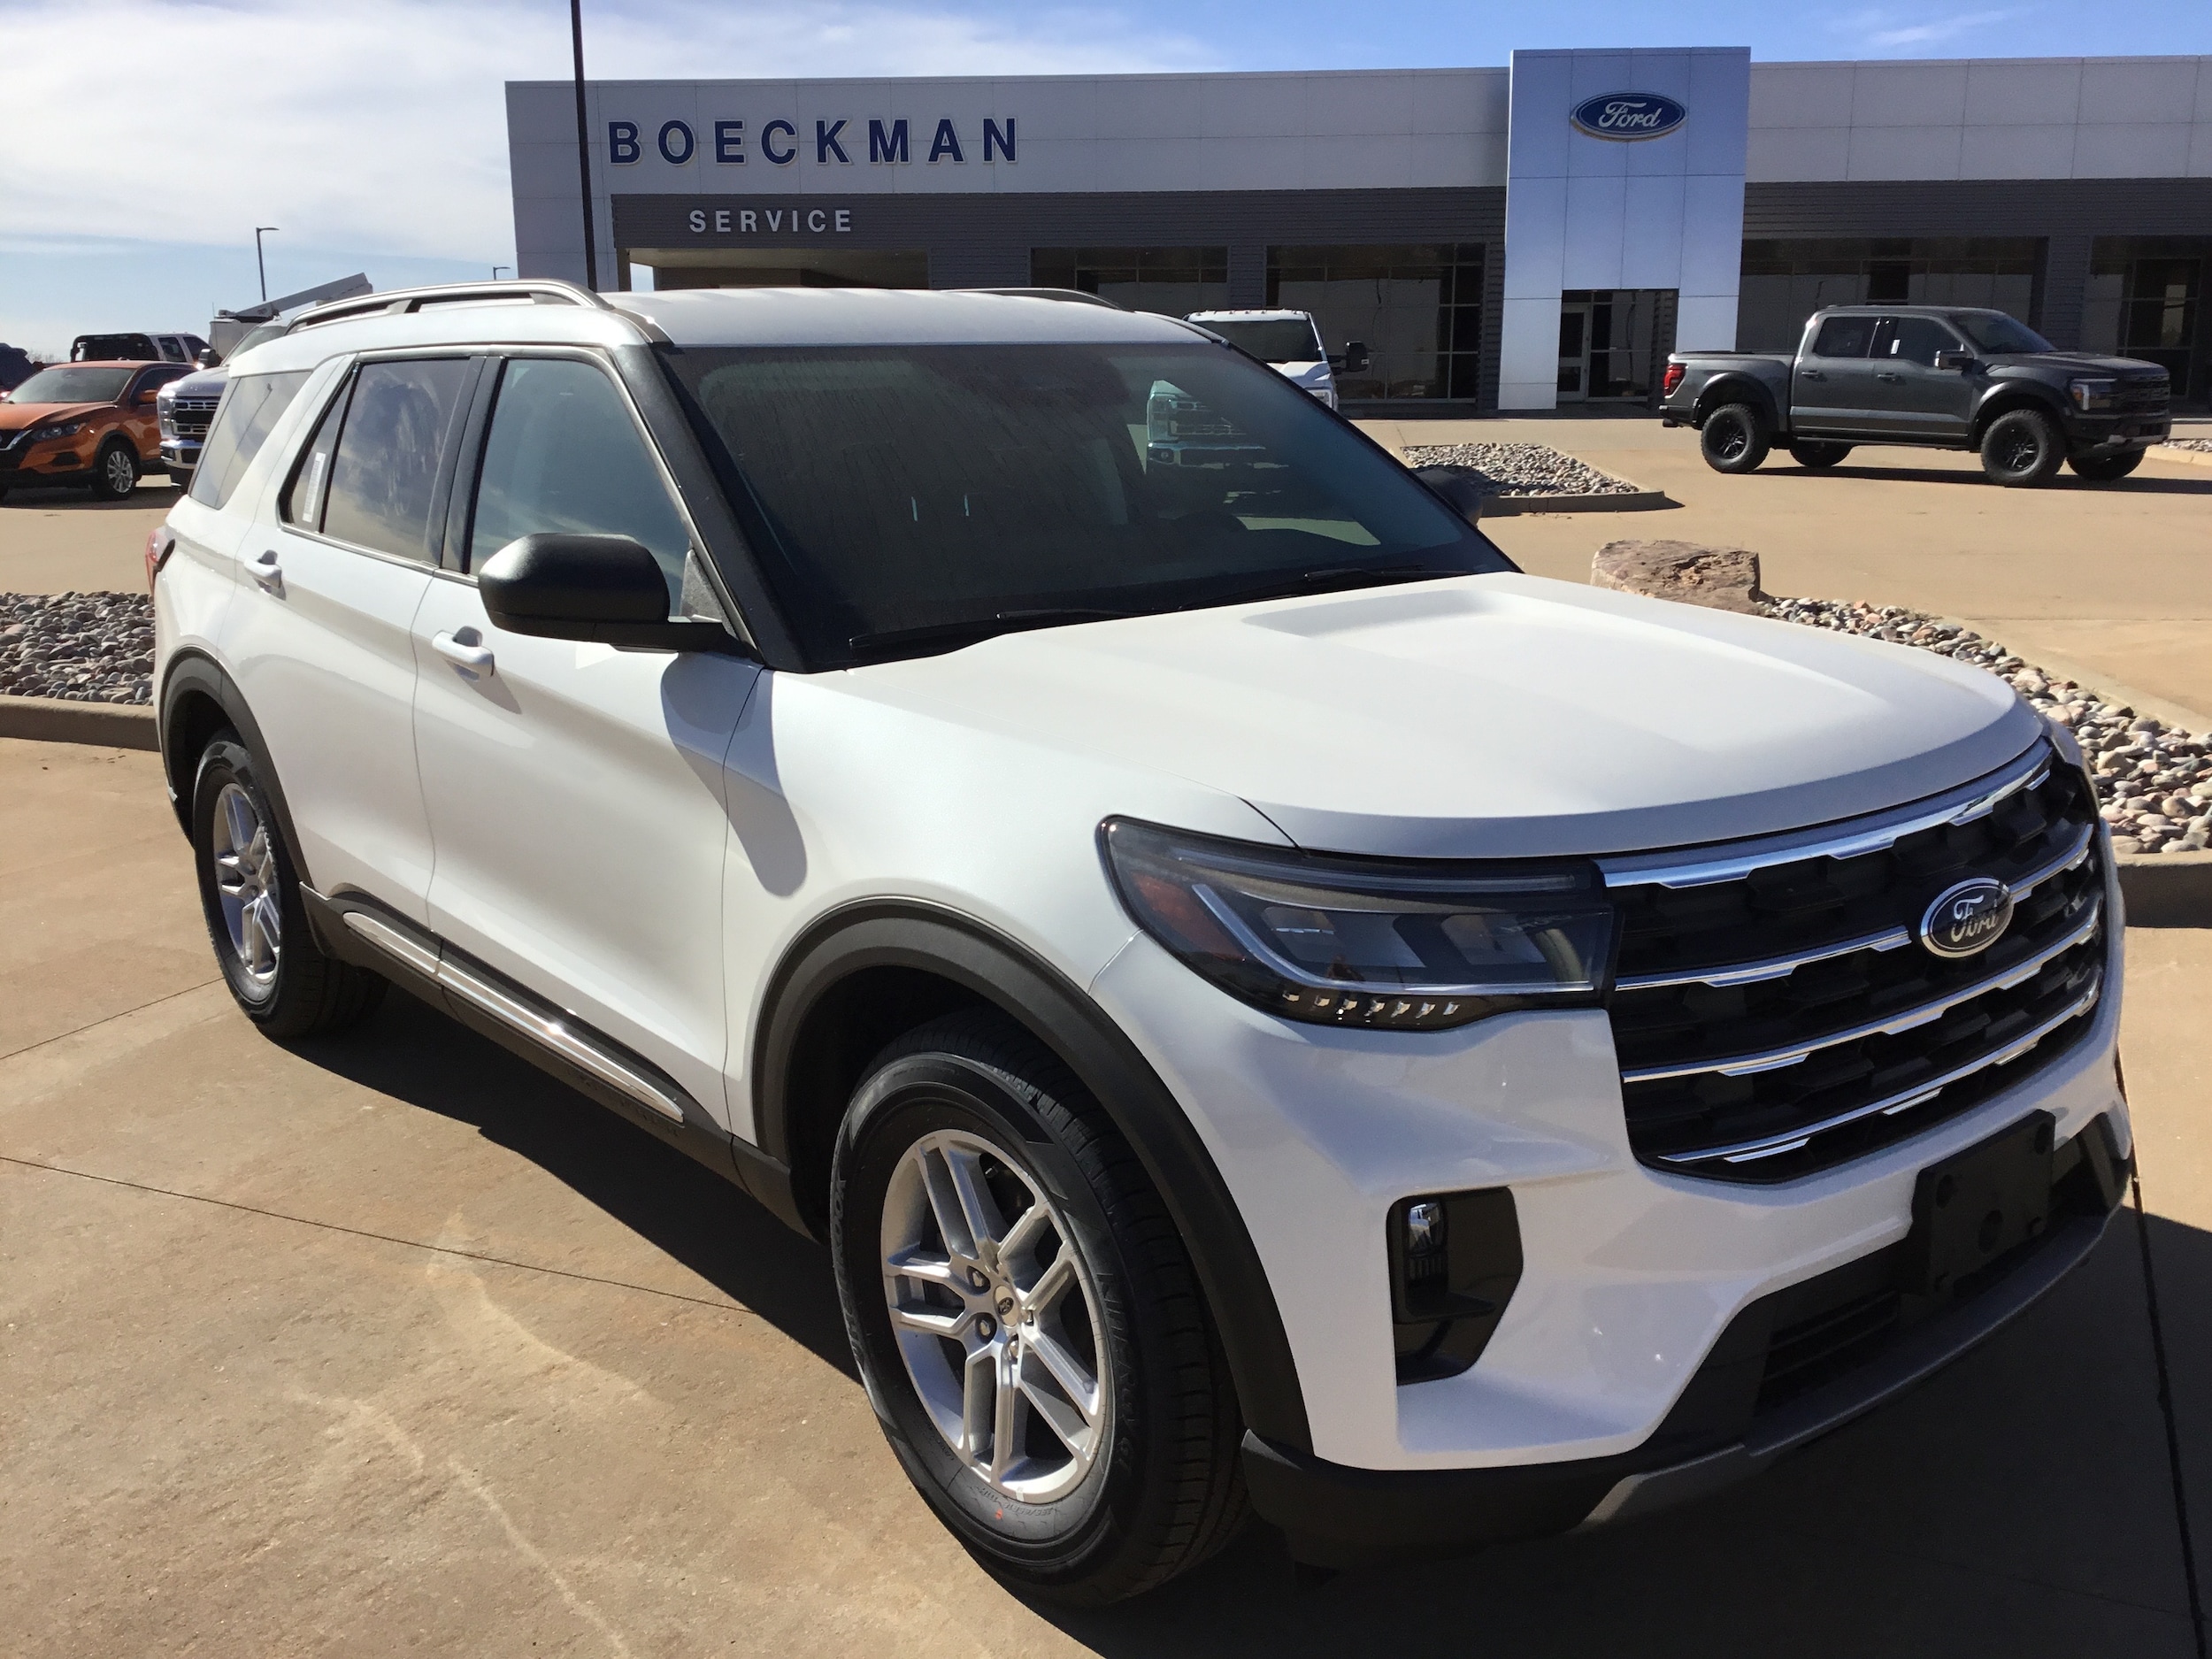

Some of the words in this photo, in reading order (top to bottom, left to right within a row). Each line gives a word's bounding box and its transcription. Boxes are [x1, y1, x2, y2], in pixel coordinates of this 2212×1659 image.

[1598, 102, 1663, 127] Ford
[608, 117, 1018, 165] BOECKMAN
[688, 209, 851, 234] SERVICE
[1950, 895, 1998, 942] Ford
